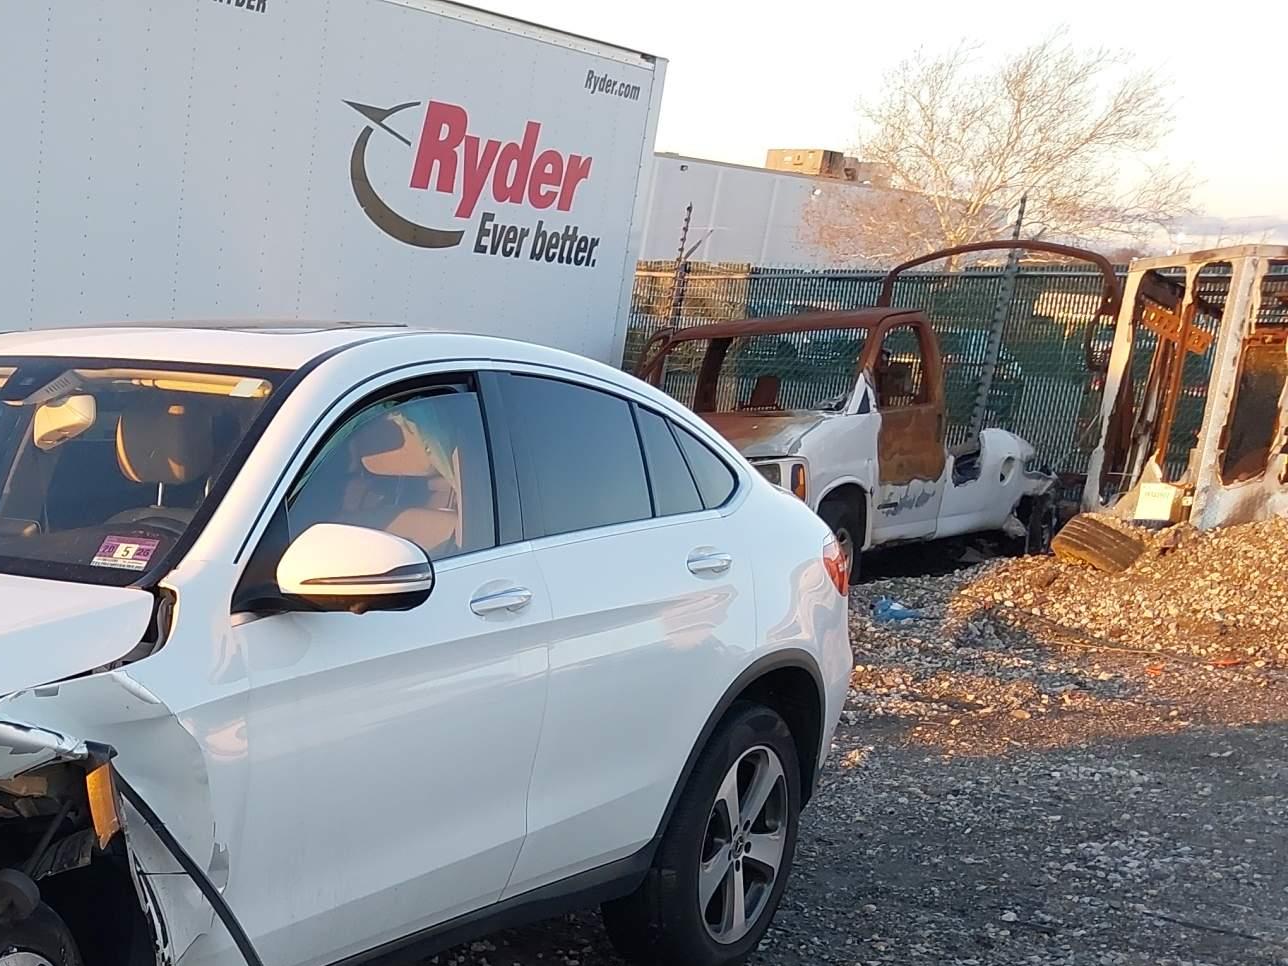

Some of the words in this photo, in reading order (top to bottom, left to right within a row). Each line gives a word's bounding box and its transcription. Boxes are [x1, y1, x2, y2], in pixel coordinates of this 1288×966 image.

[584, 69, 640, 101] Ryder.com
[409, 100, 593, 219] Ryder
[473, 211, 531, 260] Ever
[529, 220, 600, 268] better.
[121, 546, 133, 557] 5
